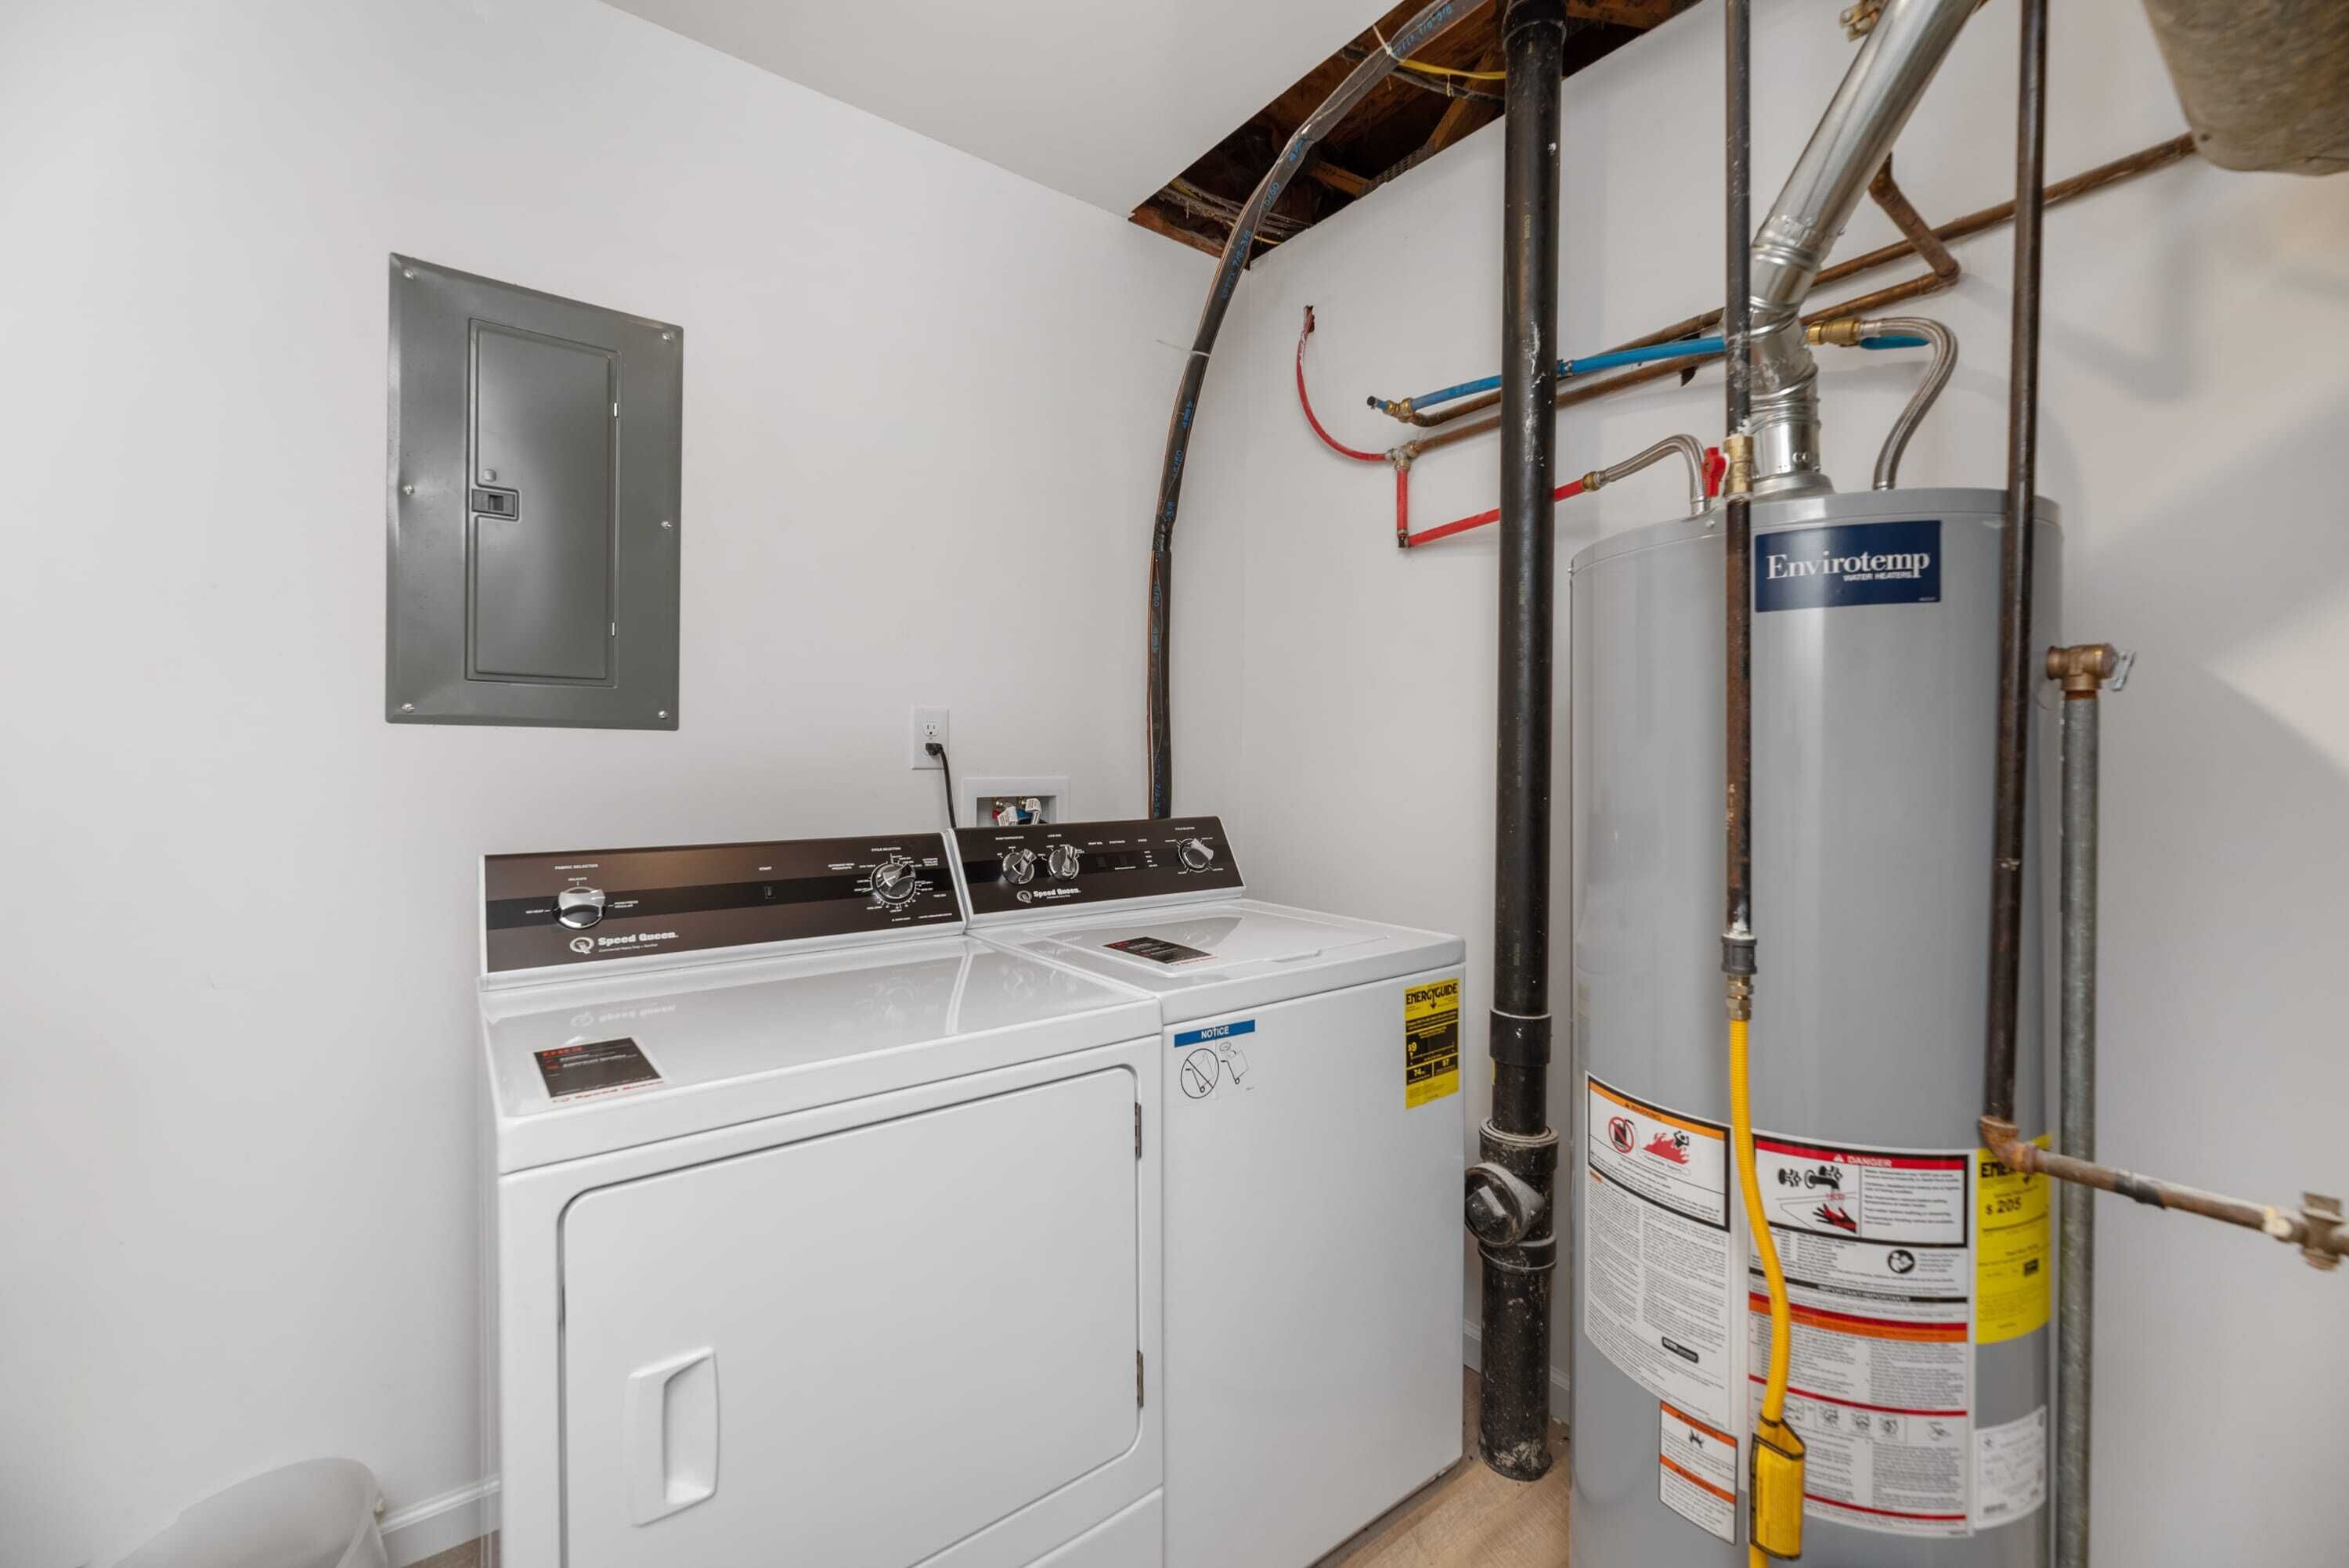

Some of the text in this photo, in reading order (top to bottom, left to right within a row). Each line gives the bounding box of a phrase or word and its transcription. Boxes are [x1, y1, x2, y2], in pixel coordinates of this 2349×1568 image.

[1766, 550, 1930, 579] Envirotemp
[1843, 573, 1873, 582] WATER
[1034, 889, 1056, 898] Speed
[597, 934, 636, 946] Speed
[1201, 1026, 1229, 1040] NOTICE
[1846, 1155, 1893, 1168] DANGER
